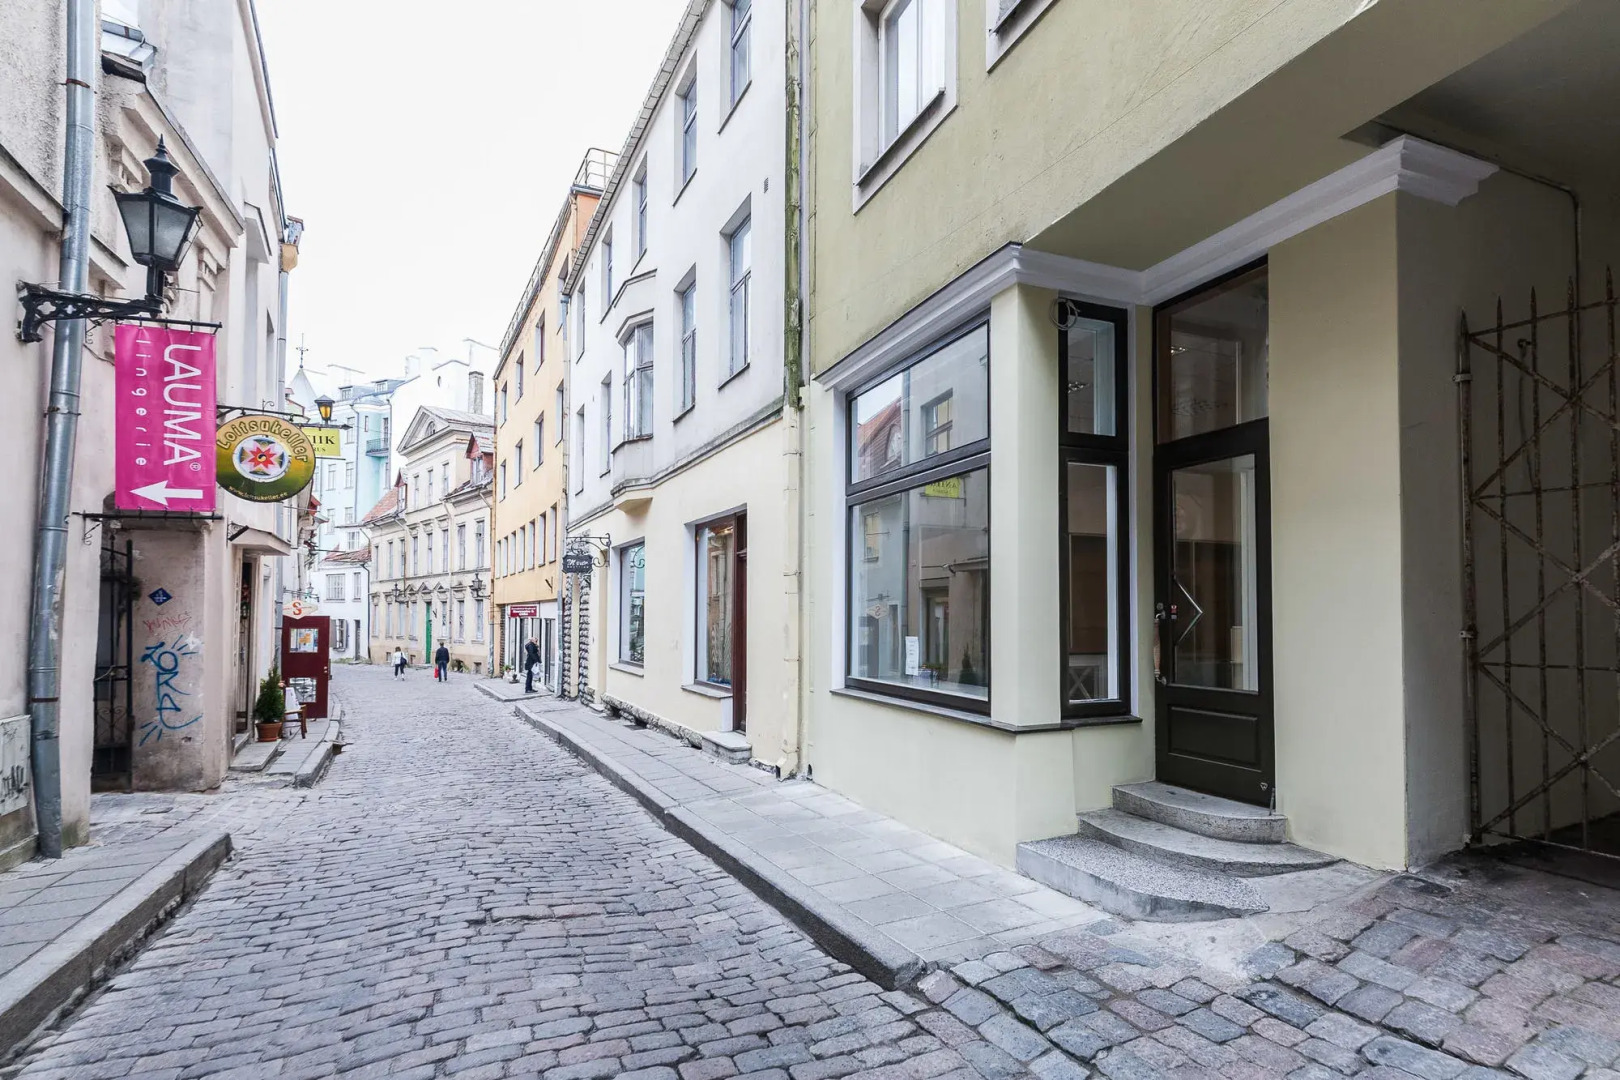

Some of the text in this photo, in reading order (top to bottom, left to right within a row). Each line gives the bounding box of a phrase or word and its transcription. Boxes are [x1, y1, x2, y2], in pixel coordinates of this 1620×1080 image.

[131, 339, 151, 466] lingerie
[216, 420, 308, 463] Loitsukeller
[292, 601, 302, 615] S
